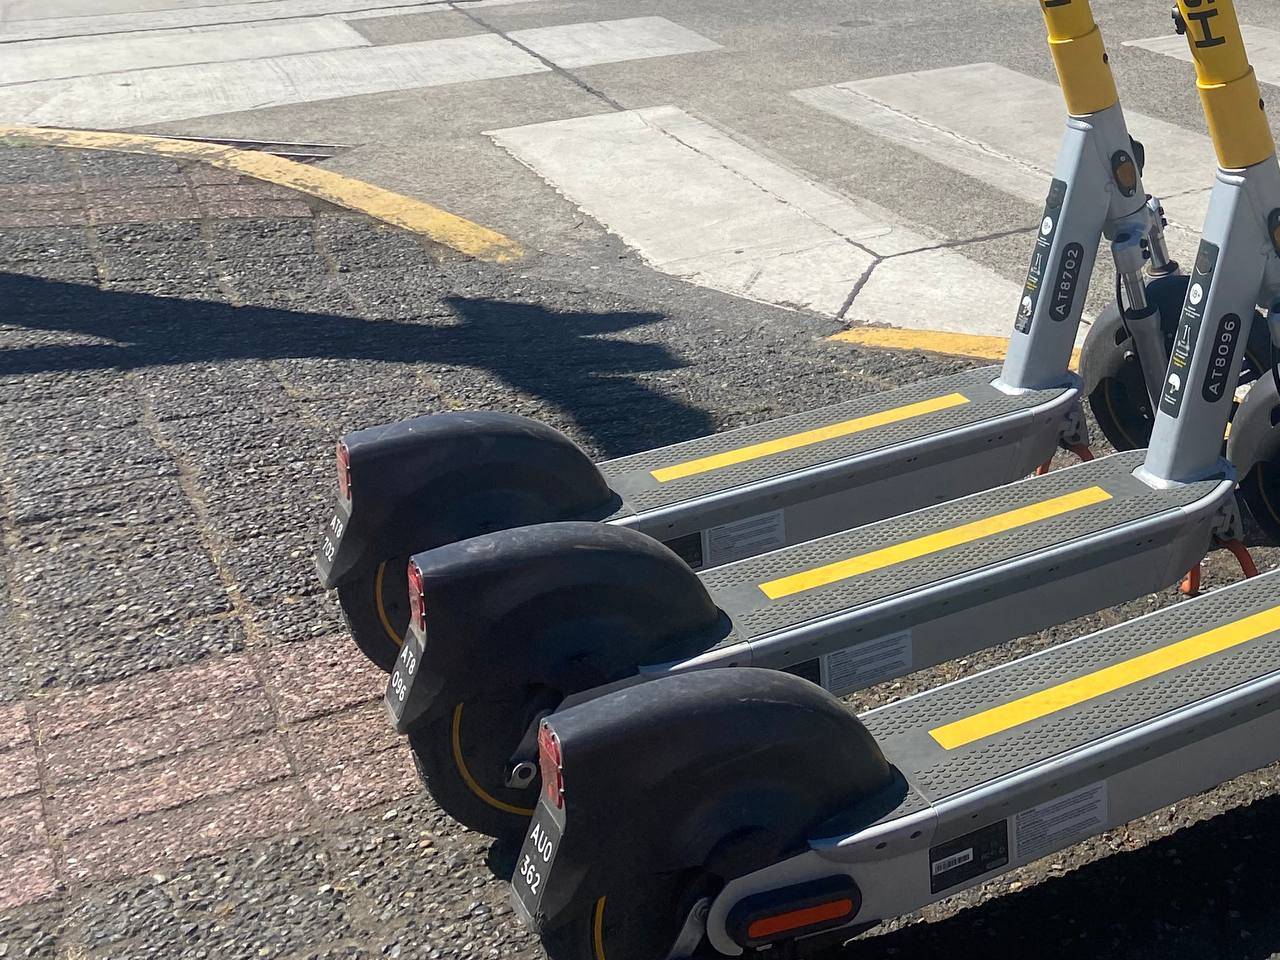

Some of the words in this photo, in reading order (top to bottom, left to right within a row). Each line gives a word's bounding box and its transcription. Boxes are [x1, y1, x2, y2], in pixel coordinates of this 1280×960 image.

[1055, 248, 1079, 316] AT8702
[1208, 320, 1236, 396] AT8096
[330, 514, 344, 538] AT8
[322, 536, 335, 562] 702
[400, 645, 417, 675] AT8
[391, 670, 407, 702] 096
[520, 853, 541, 896] 362
